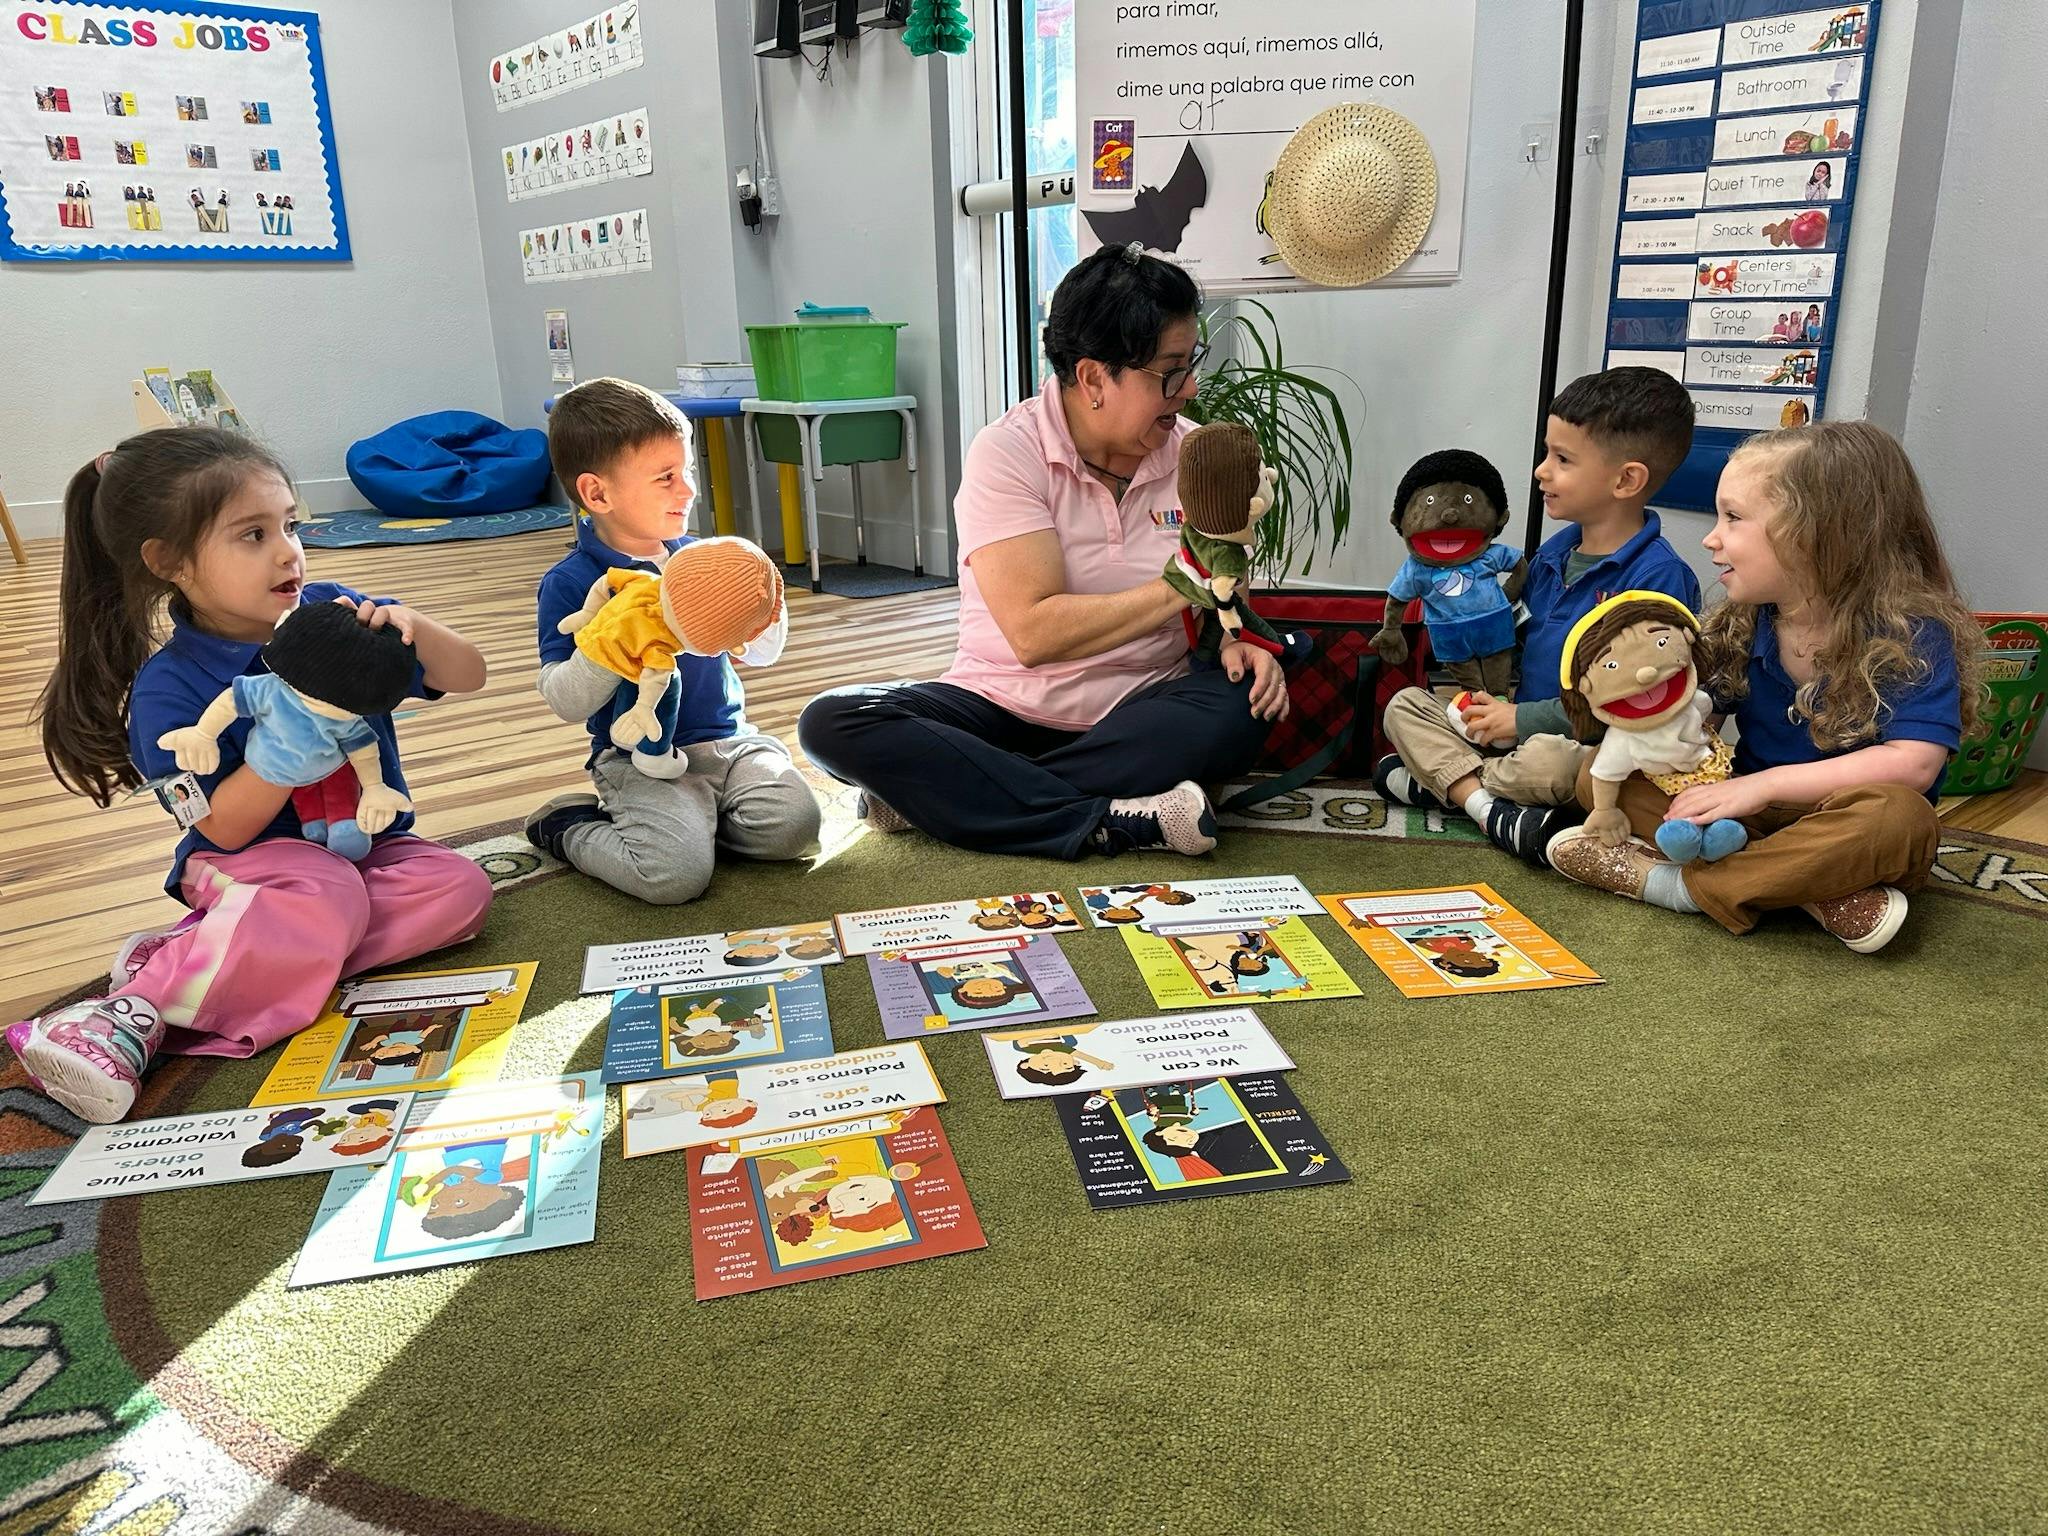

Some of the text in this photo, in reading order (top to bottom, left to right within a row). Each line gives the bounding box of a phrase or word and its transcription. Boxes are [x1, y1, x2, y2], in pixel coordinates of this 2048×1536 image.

[1116, 0, 1219, 23] para rimar,
[17, 12, 157, 47] CLASS
[172, 20, 271, 52] JOBS
[1740, 20, 1796, 39] Outside
[1116, 32, 1383, 59] rimemos aquí, rimemos allá,
[1749, 41, 1784, 55] Time
[1116, 73, 1415, 101] dime una palabra que rime con
[1737, 78, 1807, 96] Bathroom
[1179, 99, 1224, 131] at
[1105, 122, 1124, 133] Cat
[1736, 126, 1776, 143] Lunch
[1708, 175, 1784, 192] Quiet Time
[1712, 222, 1755, 237] Snack
[1739, 258, 1792, 273] Centers
[1710, 307, 1751, 322] Group
[1714, 322, 1745, 335] Time
[1701, 351, 1752, 363] Outside
[1710, 366, 1741, 379] Time
[1694, 401, 1753, 416] Dismissal
[1205, 880, 1280, 888] amables.
[1225, 887, 1300, 895] Podemos
[1221, 897, 1290, 906] friendly.
[846, 907, 936, 922] seguridad.
[859, 913, 950, 928] Valoramos
[880, 927, 938, 938] safety.
[616, 939, 707, 953] aprender.
[872, 938, 921, 947] value
[611, 948, 710, 962] Valoramos
[618, 959, 703, 972] learning.
[616, 972, 669, 982] value
[718, 976, 762, 985] Julia
[1104, 1015, 1247, 1036] trabajar duro.
[1136, 1029, 1230, 1045] Podemos
[1136, 1043, 1248, 1062] work hard.
[768, 1050, 897, 1075] cuidadosos.
[1161, 1057, 1240, 1071] We can
[766, 1061, 906, 1090] Podemos ser
[816, 1086, 869, 1100] safe.
[788, 1093, 906, 1119] We can be
[1255, 1108, 1298, 1118] ESTRELLA
[106, 1115, 258, 1139] a los demás.
[104, 1130, 236, 1152] Valoramos
[1286, 1145, 1316, 1153] Trabaja
[114, 1152, 204, 1169] others.
[87, 1166, 204, 1187] We value
[703, 1176, 739, 1189] jugador
[702, 1186, 740, 1197] Un buen
[927, 1185, 951, 1193] Lleno
[1086, 1178, 1149, 1191] profundamente
[699, 1201, 746, 1214] Incluyente
[941, 1212, 960, 1220] bien
[702, 1219, 754, 1234] fantástico!
[931, 1221, 957, 1231] Juega
[707, 1228, 751, 1241] ayudante
[719, 1252, 751, 1263] actuar
[714, 1260, 757, 1274] antes de
[720, 1270, 753, 1282] Piensa
